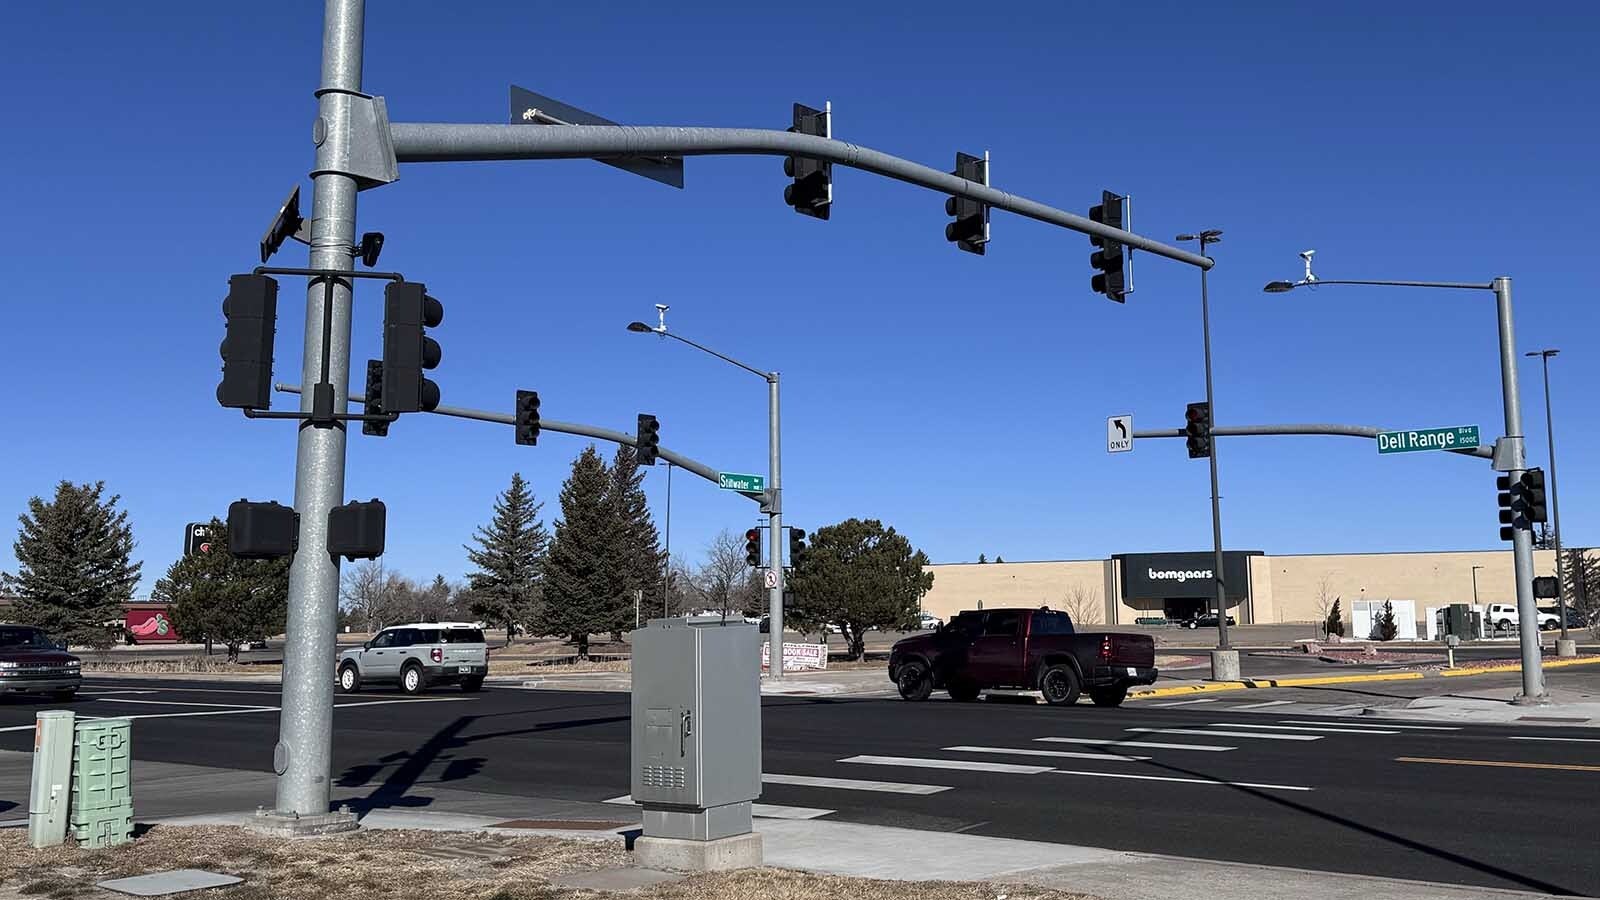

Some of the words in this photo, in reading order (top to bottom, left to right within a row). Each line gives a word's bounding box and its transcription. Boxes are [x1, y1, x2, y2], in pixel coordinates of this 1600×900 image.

[1110, 440, 1130, 449] ONLY
[1379, 433, 1405, 449] Dell
[1409, 432, 1455, 448] Range
[720, 474, 749, 489] Stillwater
[1148, 567, 1213, 582] bomgaars
